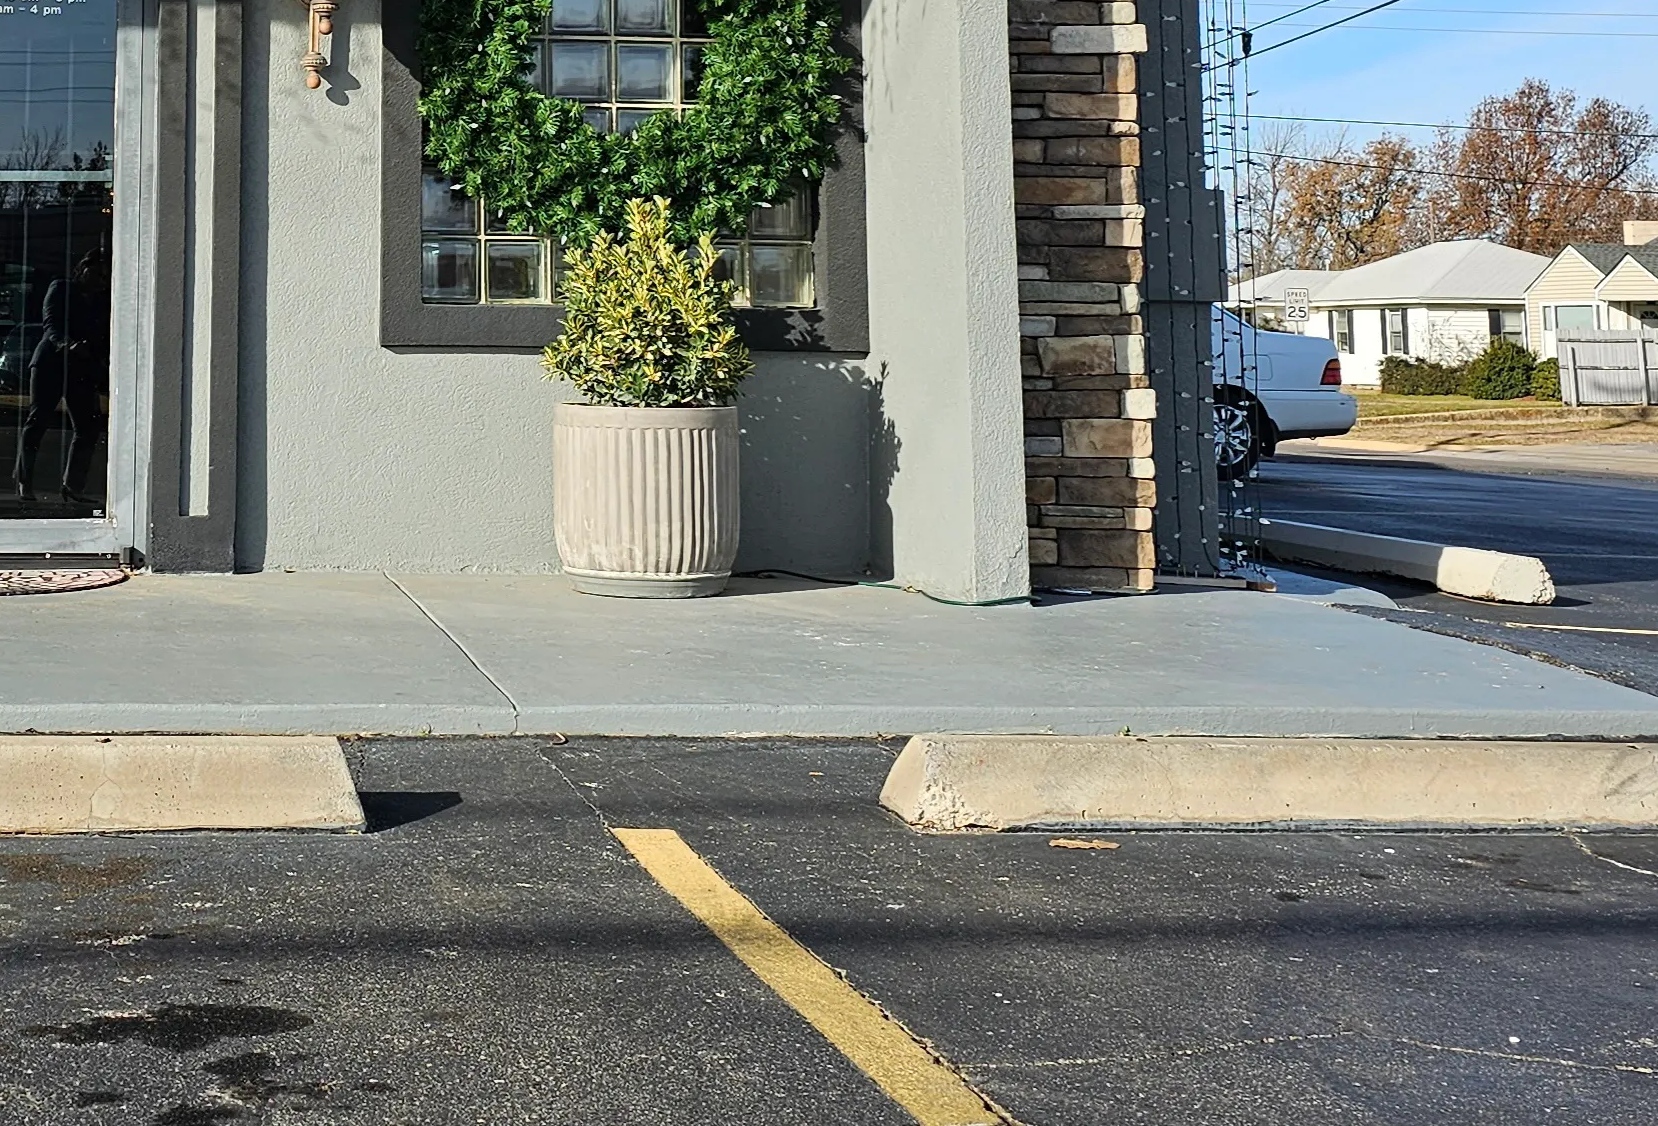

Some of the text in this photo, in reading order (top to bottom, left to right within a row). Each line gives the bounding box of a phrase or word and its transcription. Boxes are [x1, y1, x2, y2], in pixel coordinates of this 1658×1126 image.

[30, 4, 38, 14] 4
[43, 5, 62, 16] pm
[1288, 306, 1306, 318] 25
